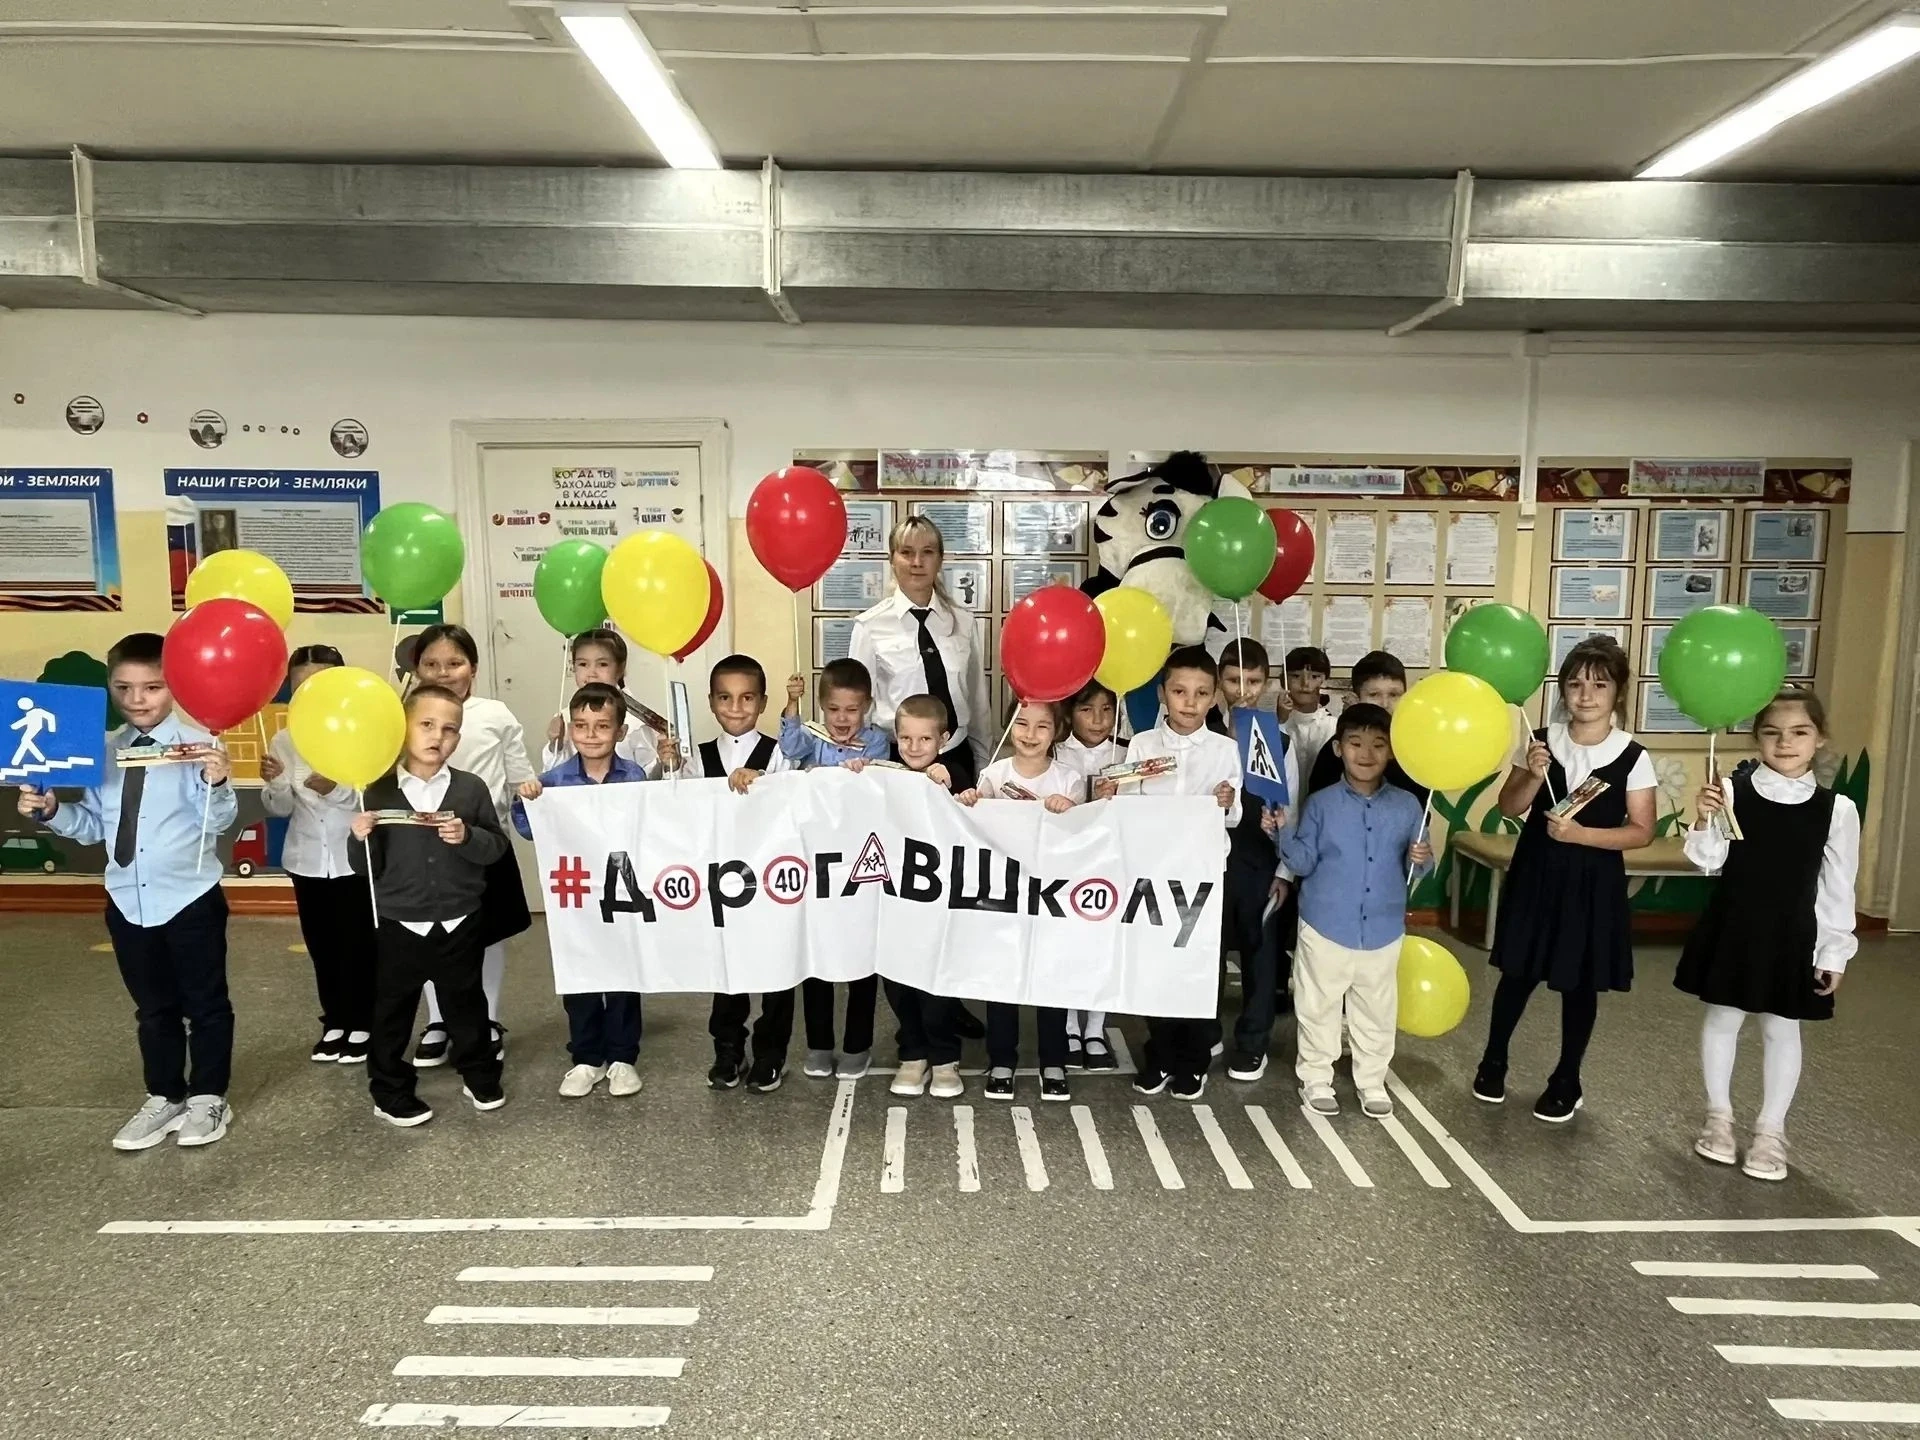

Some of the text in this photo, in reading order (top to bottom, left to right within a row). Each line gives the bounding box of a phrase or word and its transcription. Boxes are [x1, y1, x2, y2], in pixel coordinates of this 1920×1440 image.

[555, 469, 614, 479] КОГДА ТЫ
[27, 475, 101, 487] ЗЕМЛЯКИ
[177, 476, 226, 488] НАШИ
[229, 476, 280, 488] ГЕРОИ
[293, 477, 368, 489] ЗЕМЛЯКИ
[555, 479, 617, 490] ЗАХОДИШЬ
[562, 489, 608, 499] В КЛАСС
[563, 527, 590, 536] ОЧЕНЬ
